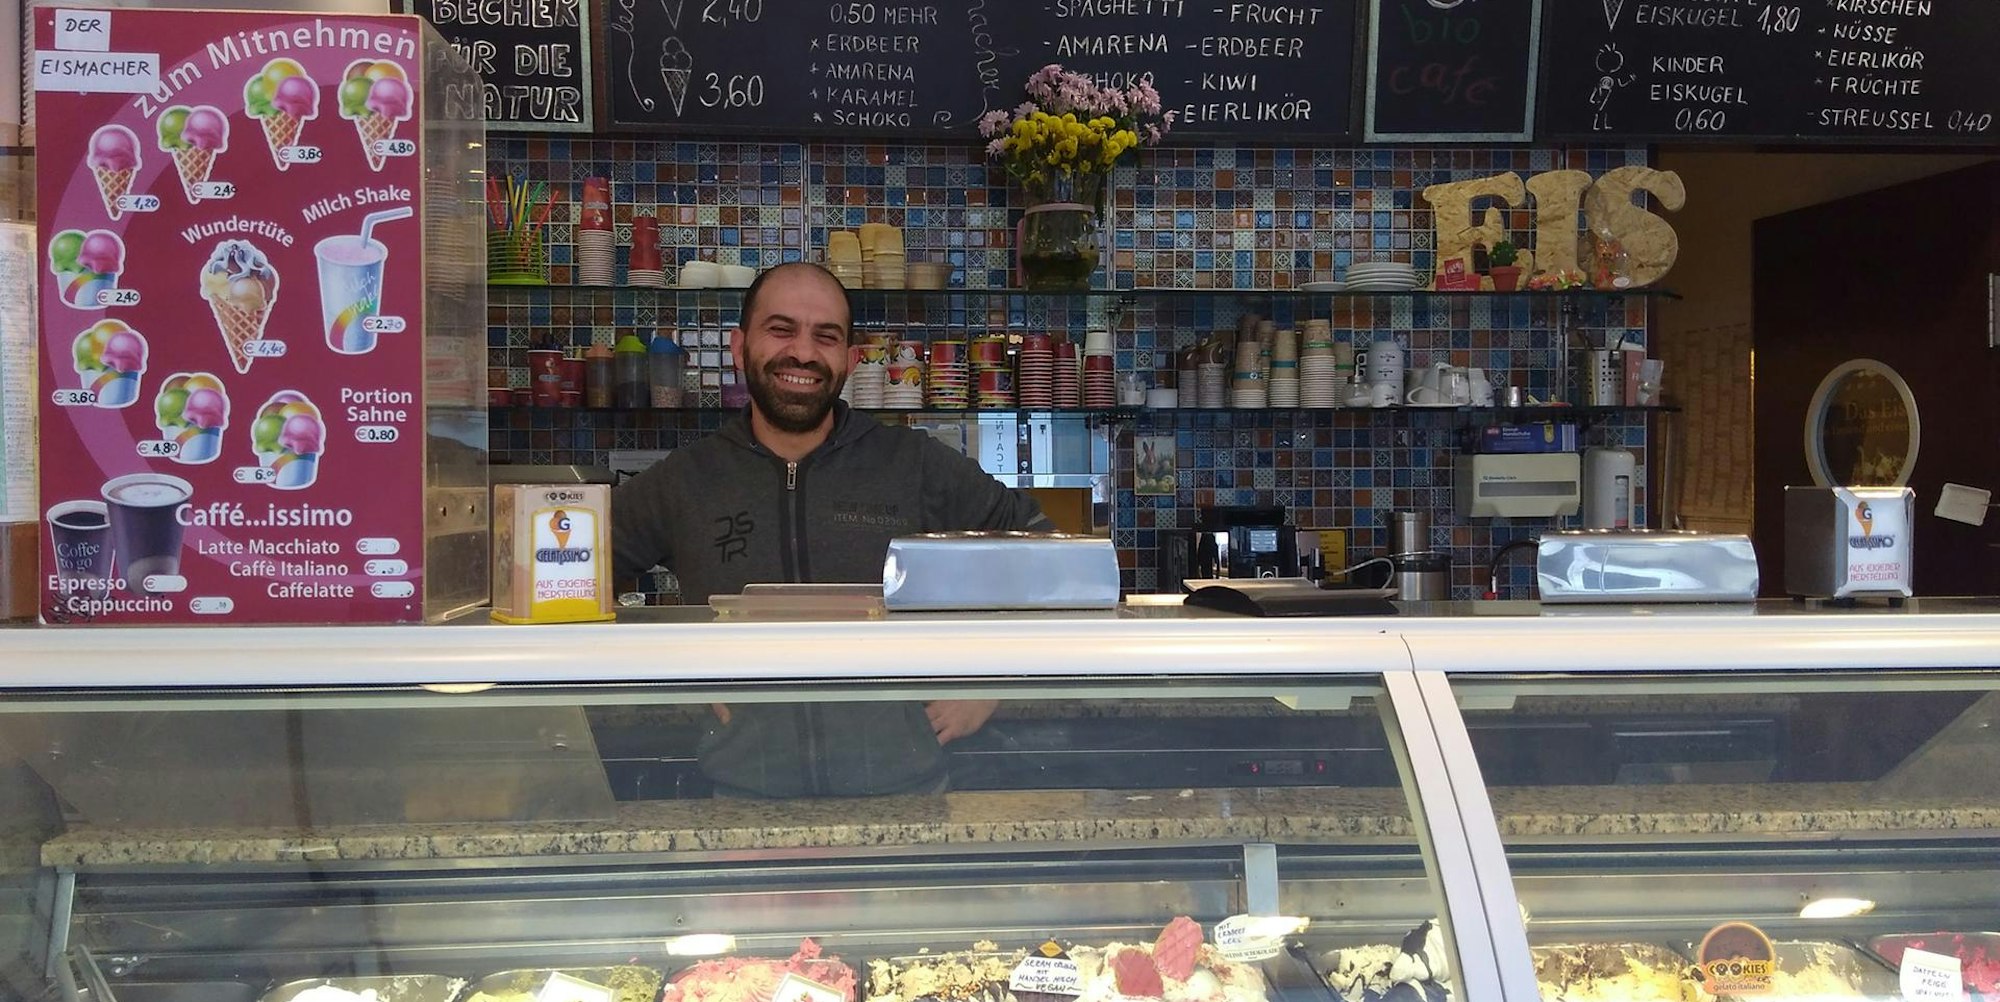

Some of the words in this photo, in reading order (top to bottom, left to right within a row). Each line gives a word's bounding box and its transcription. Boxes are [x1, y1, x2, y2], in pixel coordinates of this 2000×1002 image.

[431, 0, 580, 28] BECHER
[702, 0, 763, 28] 2,40
[829, 3, 876, 28] 0,50
[884, 6, 939, 26] MEHR
[1055, 0, 1186, 19] SPAGHETTI
[1230, 5, 1323, 26] FRUCHT
[1836, 0, 1932, 17] KIRSCHEN
[65, 18, 104, 33] DER
[1636, 5, 1743, 29] EISKUGEL
[1757, 5, 1801, 35] 1,80
[1833, 21, 1898, 44] NÜSSE
[826, 34, 920, 55] ERDBEER
[1055, 33, 1169, 58] AMARENA
[1201, 36, 1304, 59] ERDBEER
[41, 60, 151, 76] EISMACHER
[514, 43, 574, 78] DIE
[1652, 56, 1724, 74] KINDER
[1827, 46, 1925, 70] EIERLIKÖR
[133, 61, 202, 119] zum
[206, 19, 416, 70] Mitnehmen
[825, 63, 915, 83] AMARENA
[699, 72, 765, 111] 3,60
[1094, 71, 1155, 91] HOKO
[1201, 72, 1257, 92] KIWI
[1831, 74, 1922, 97] FRÜCHTE
[445, 83, 580, 122] NATUR
[827, 87, 919, 108] KARAMEL
[1650, 84, 1748, 105] EISKUGEL
[832, 109, 911, 128] SCHOKO
[1183, 94, 1312, 123] EIERLIKÖR
[1674, 109, 1726, 133] 0,60
[1818, 109, 1933, 130] STREUSSEL
[303, 193, 353, 224] Milch
[354, 184, 411, 206] Shake
[181, 215, 294, 248] Wundertüte
[1422, 165, 1686, 292] EIS
[341, 388, 412, 405] Portion
[347, 406, 407, 423] Sahne
[175, 503, 353, 527] Caffé...issimo
[57, 541, 101, 558] Coffee
[199, 538, 244, 555] Latte
[249, 537, 341, 555] Macchiato
[230, 560, 276, 577] Caffè
[281, 560, 349, 577] Italiano
[48, 574, 127, 594] Espresso
[267, 582, 354, 599] Caffelatte
[68, 595, 173, 616] Cappuccino
[1709, 963, 1767, 976] COOKIES
